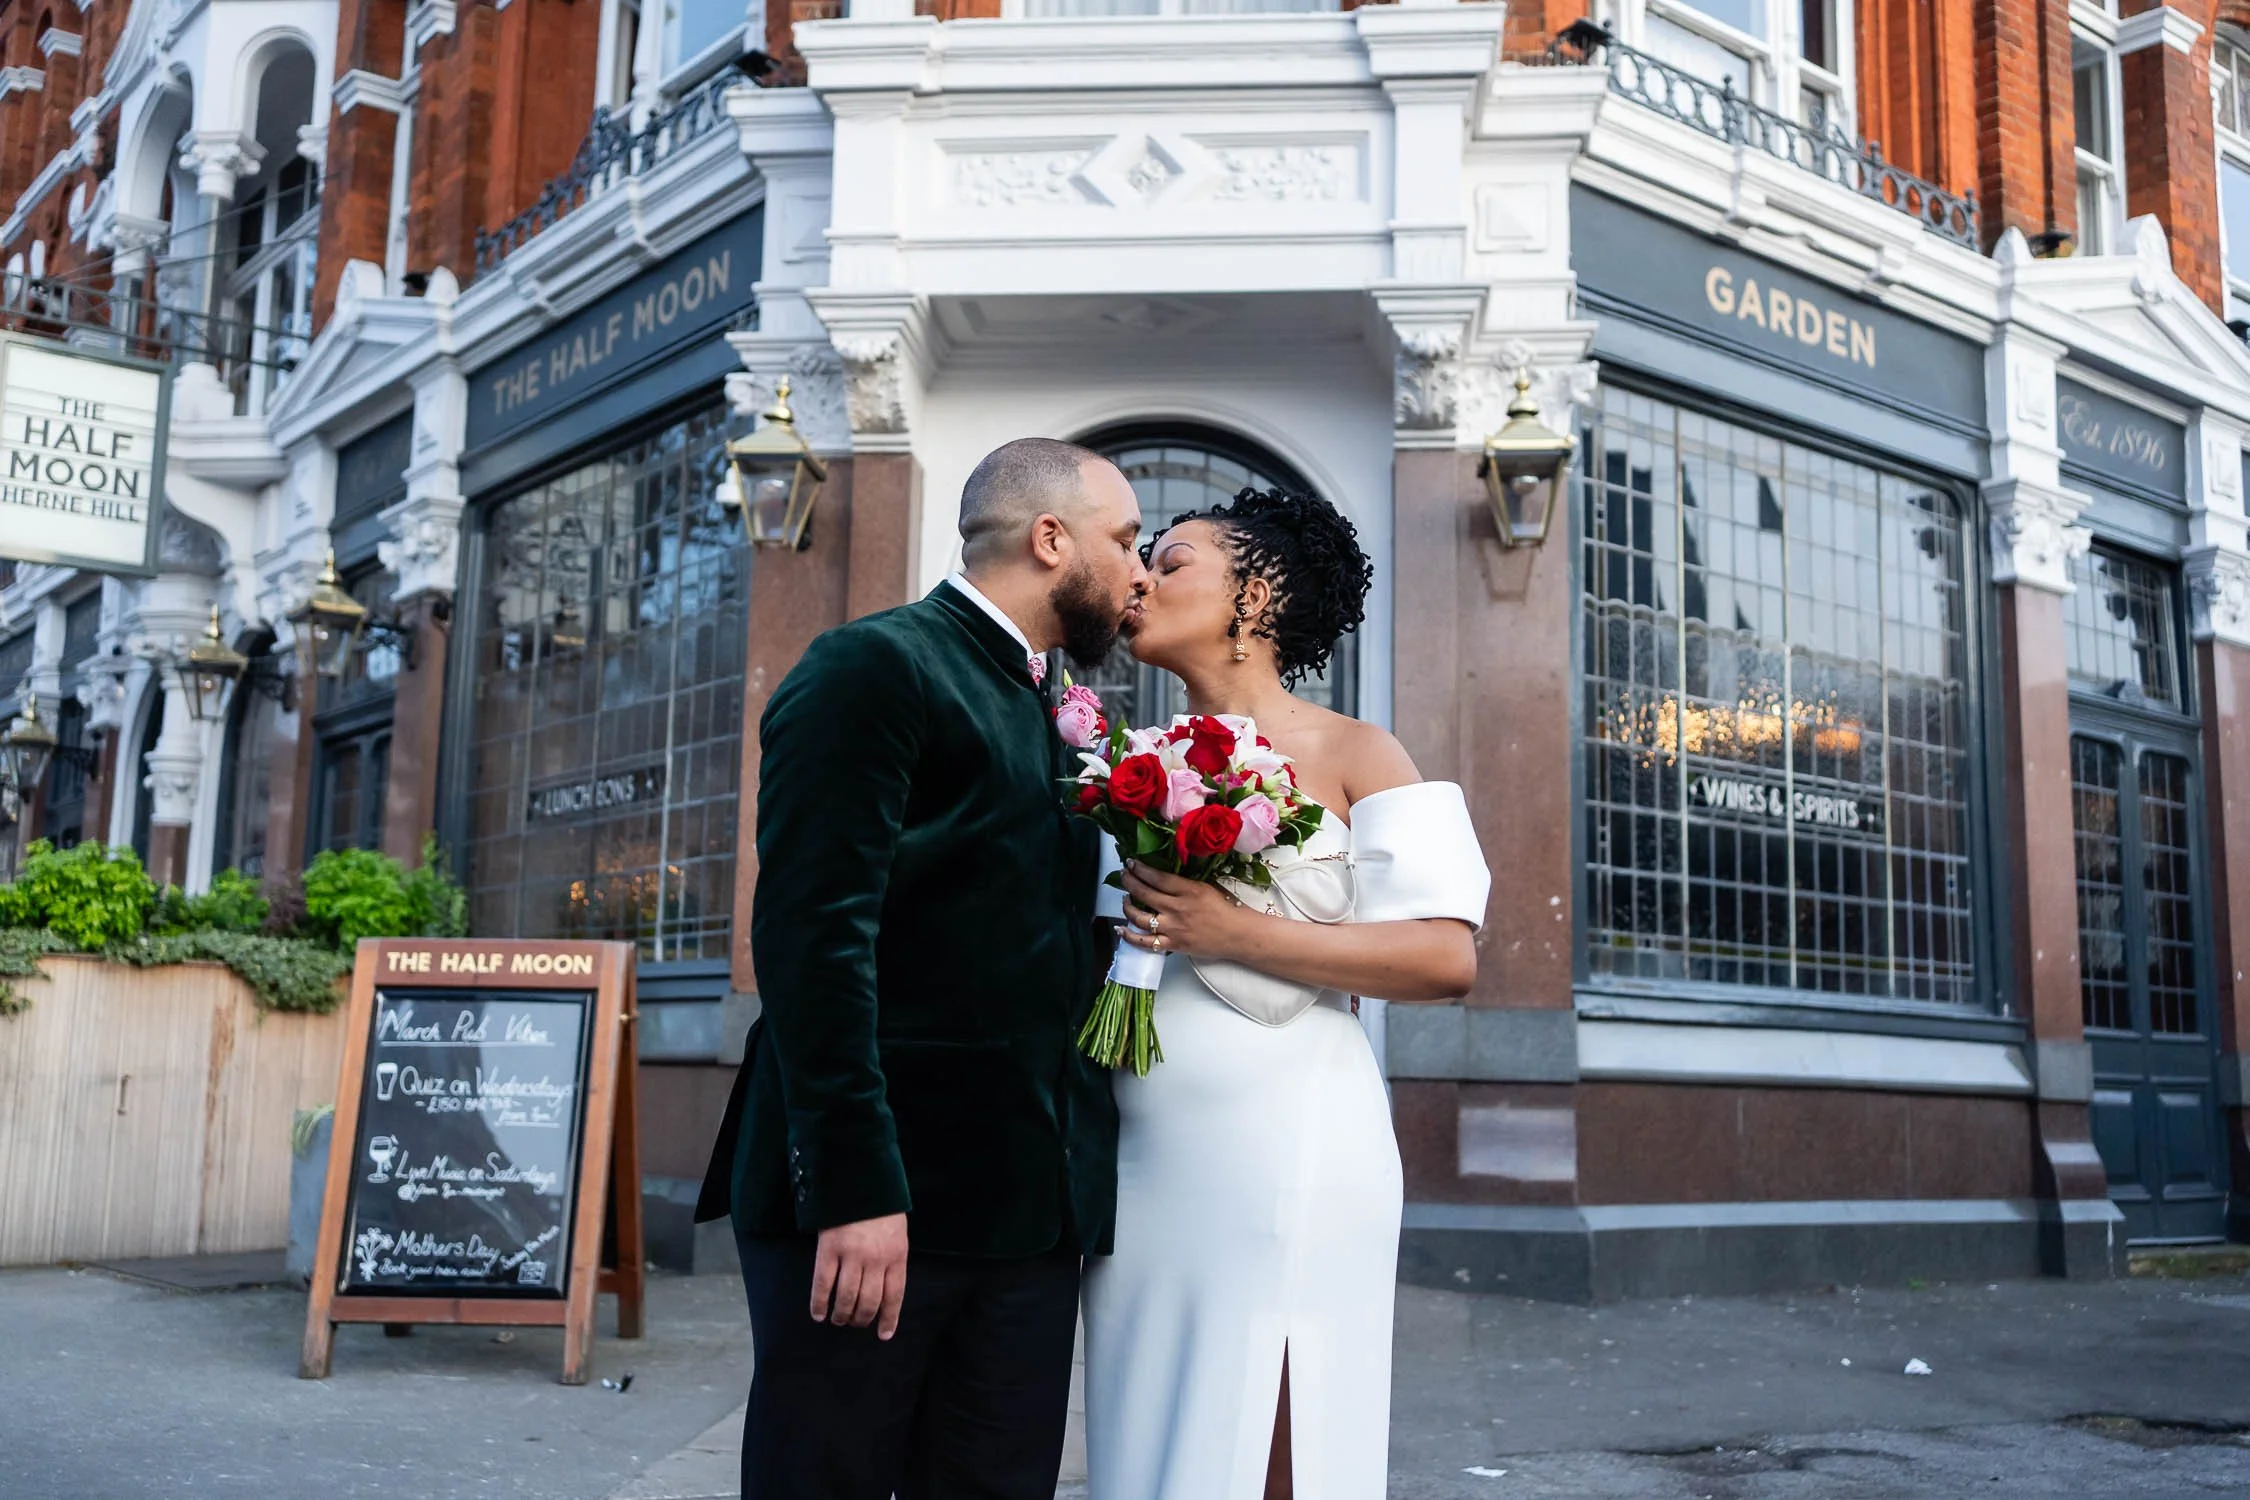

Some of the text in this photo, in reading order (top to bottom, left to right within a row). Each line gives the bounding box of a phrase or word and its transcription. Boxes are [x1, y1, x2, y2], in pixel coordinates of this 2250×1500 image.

[494, 249, 731, 415] THE HALF MOON
[1705, 266, 1876, 369] GARDEN
[58, 395, 104, 421] THE
[24, 416, 133, 459] HALF
[9, 450, 138, 498] MOON
[2, 484, 143, 523] HERNE HILL
[1700, 775, 1860, 828] WINES & SPIRITS
[387, 951, 593, 975] THE HALF MOON
[378, 1008, 441, 1041] March
[451, 1009, 490, 1041] Pub
[400, 1065, 445, 1096] Quiz
[450, 1079, 471, 1096] on
[468, 1167, 485, 1182] on
[466, 1233, 502, 1266] Day
